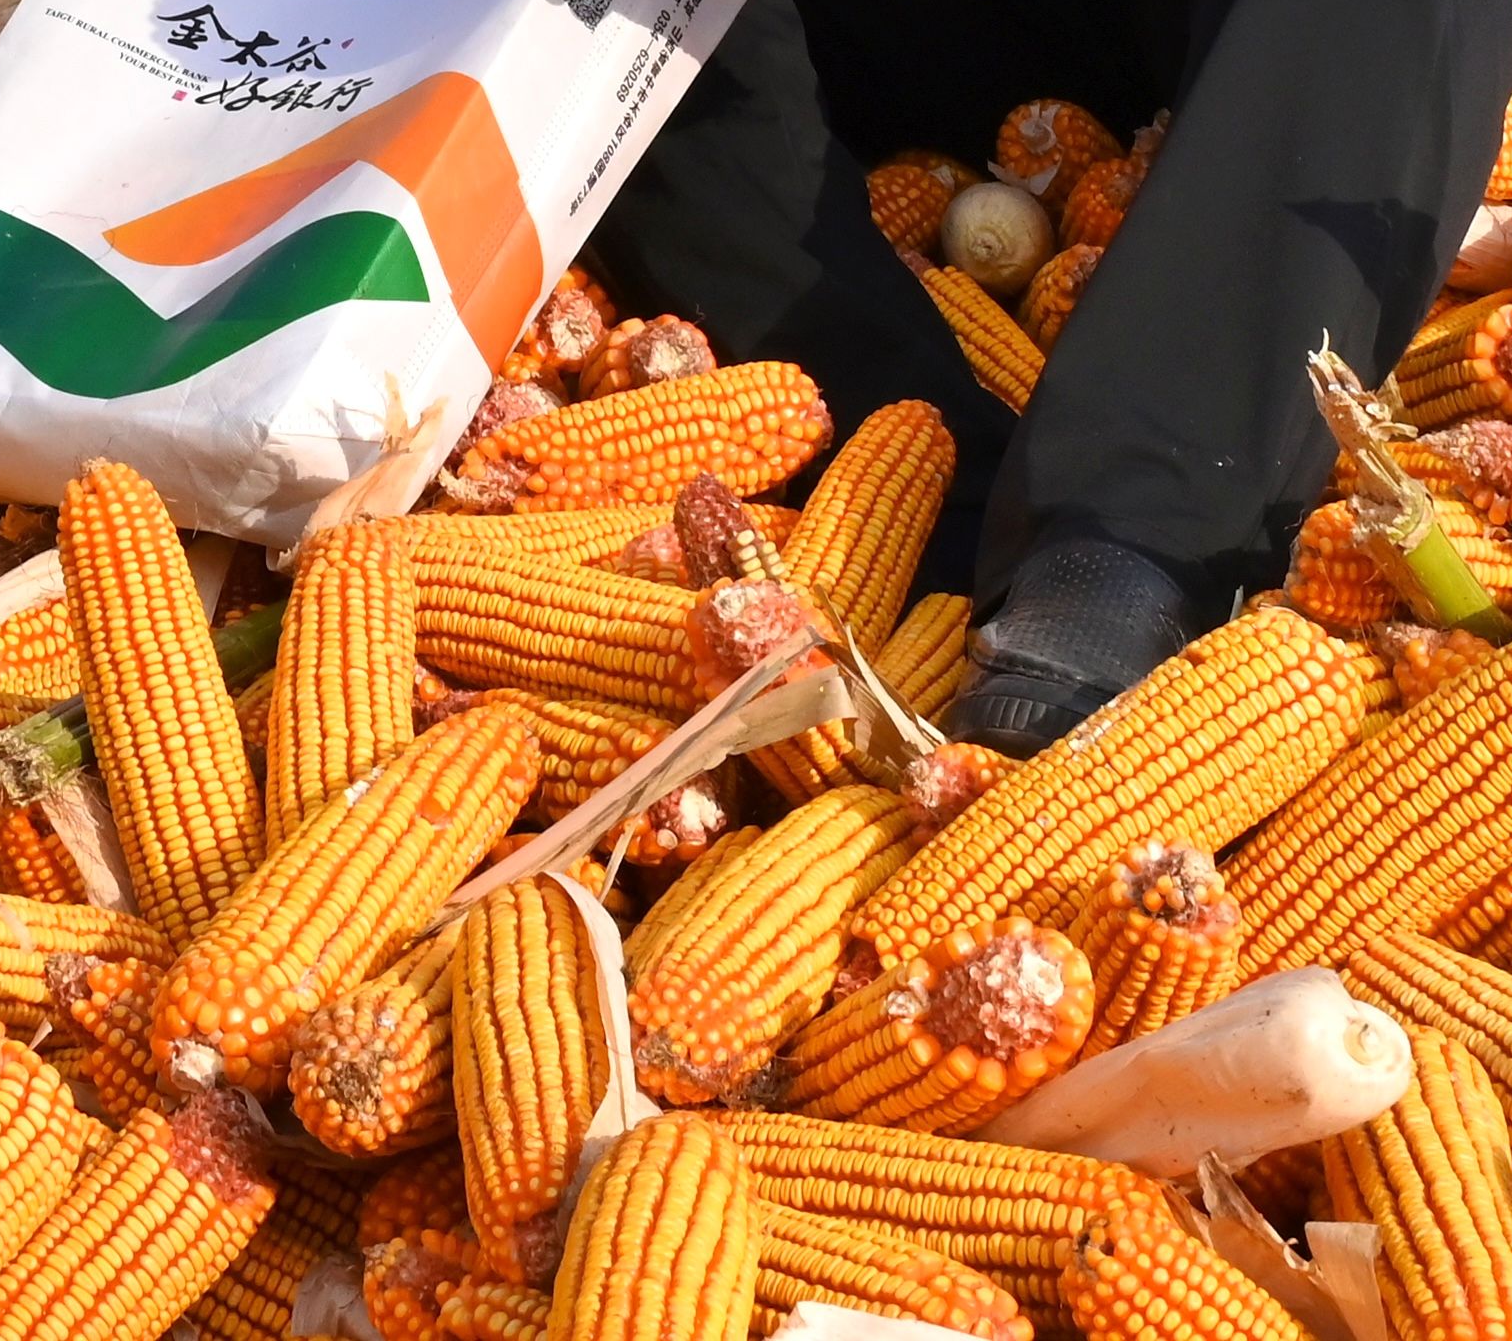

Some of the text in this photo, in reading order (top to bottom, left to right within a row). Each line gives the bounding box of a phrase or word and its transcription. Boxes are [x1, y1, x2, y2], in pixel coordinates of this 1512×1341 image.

[44, 7, 212, 85] TAIGU RURAL COMMERCIAL BANK
[118, 51, 206, 94] YOUR BEST BANK
[156, 3, 332, 74] 金太谷
